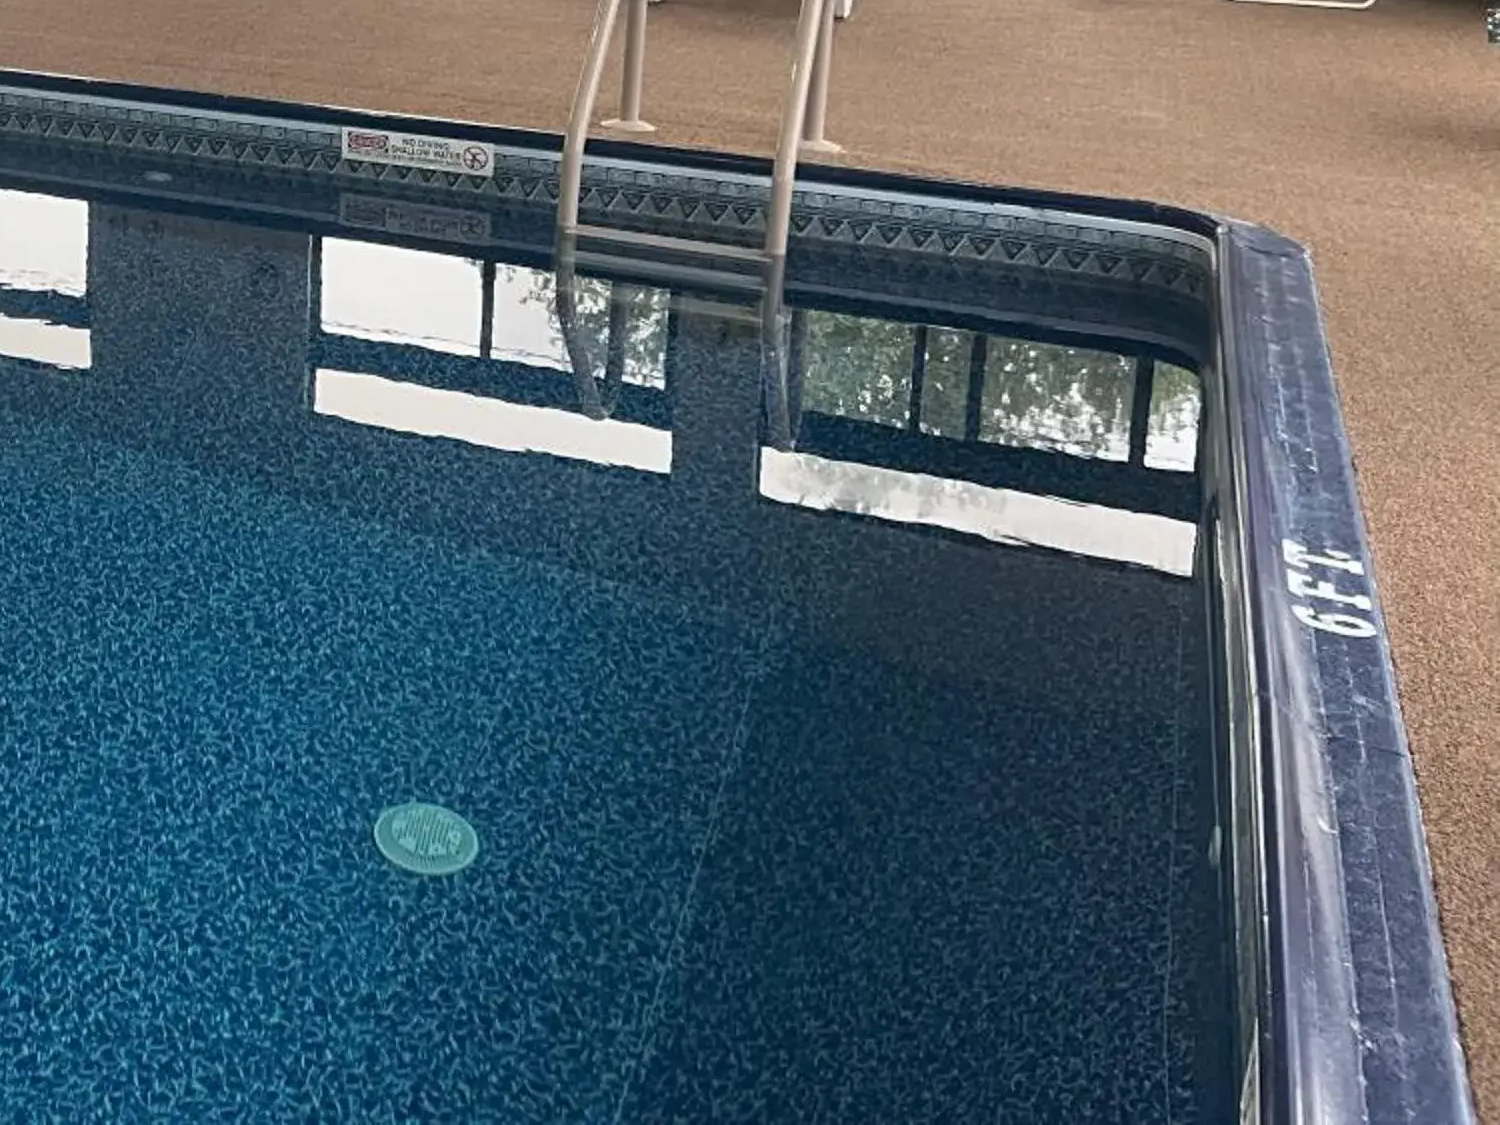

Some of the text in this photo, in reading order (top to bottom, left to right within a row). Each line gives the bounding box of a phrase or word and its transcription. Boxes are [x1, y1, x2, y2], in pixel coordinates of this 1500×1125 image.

[402, 138, 450, 151] NO DIVING
[1281, 538, 1378, 638] 6FT
